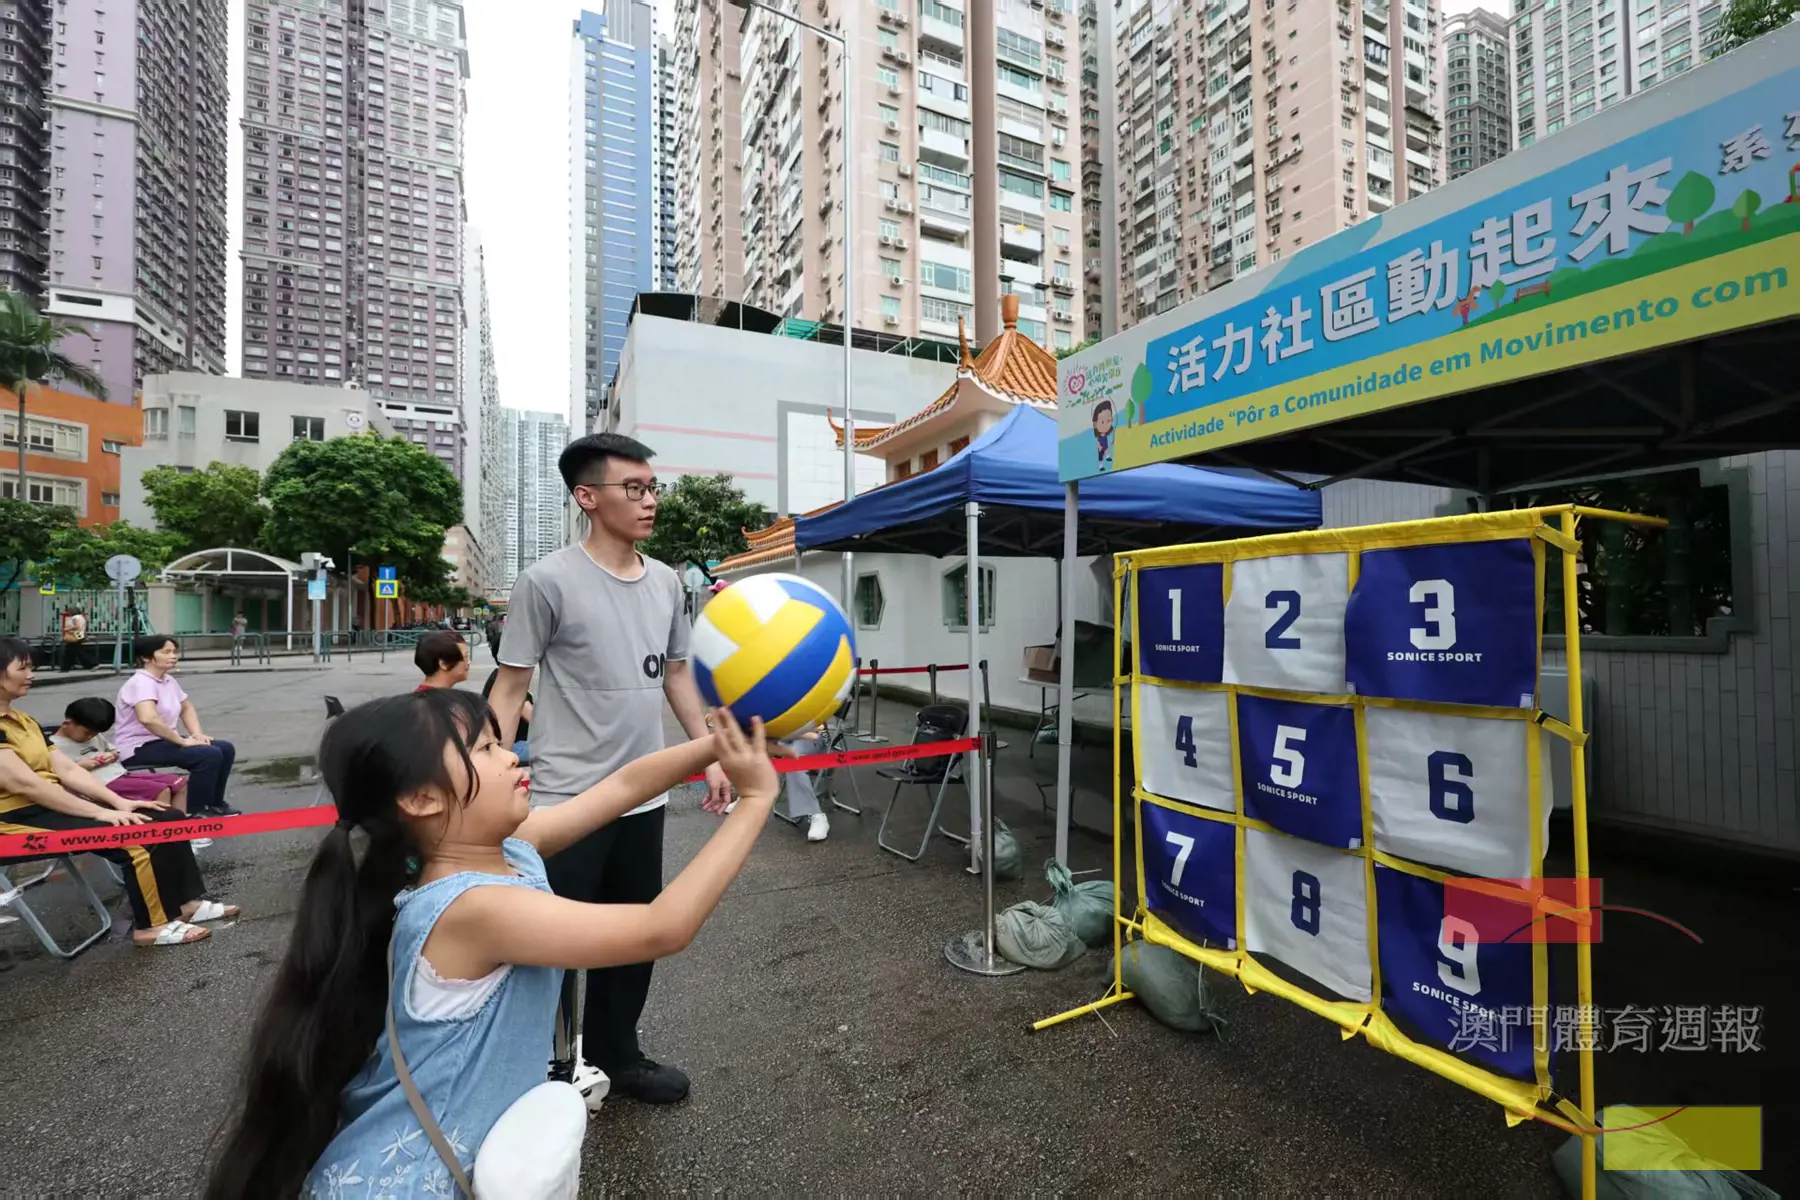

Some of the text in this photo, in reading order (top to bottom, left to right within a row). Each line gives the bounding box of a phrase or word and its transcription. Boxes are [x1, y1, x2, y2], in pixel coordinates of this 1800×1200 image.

[1167, 157, 1673, 396] 活力社區動起來
[1150, 417, 1224, 448] Actividade
[1269, 404, 1279, 417] a
[1284, 364, 1422, 413] Comunidade
[1430, 351, 1471, 376] em
[1480, 294, 1679, 364] Movimento
[1691, 266, 1788, 309] com
[1168, 588, 1182, 641] 1
[1265, 589, 1301, 650] 2
[1409, 579, 1457, 650] 3
[1155, 644, 1200, 653] SONICE SPORT
[1387, 652, 1482, 662] SONICE SPORT
[1175, 715, 1198, 768] 4
[1270, 724, 1307, 789] 5
[1257, 782, 1318, 805] SONICE SPORT
[1427, 750, 1475, 824] 6
[61, 821, 224, 847] www.sport.gov.mo
[1166, 830, 1195, 887] 7
[1180, 892, 1205, 907] SPORT
[1290, 869, 1322, 936] 8
[1437, 914, 1482, 996] 9
[1412, 982, 1460, 1007] SONICE
